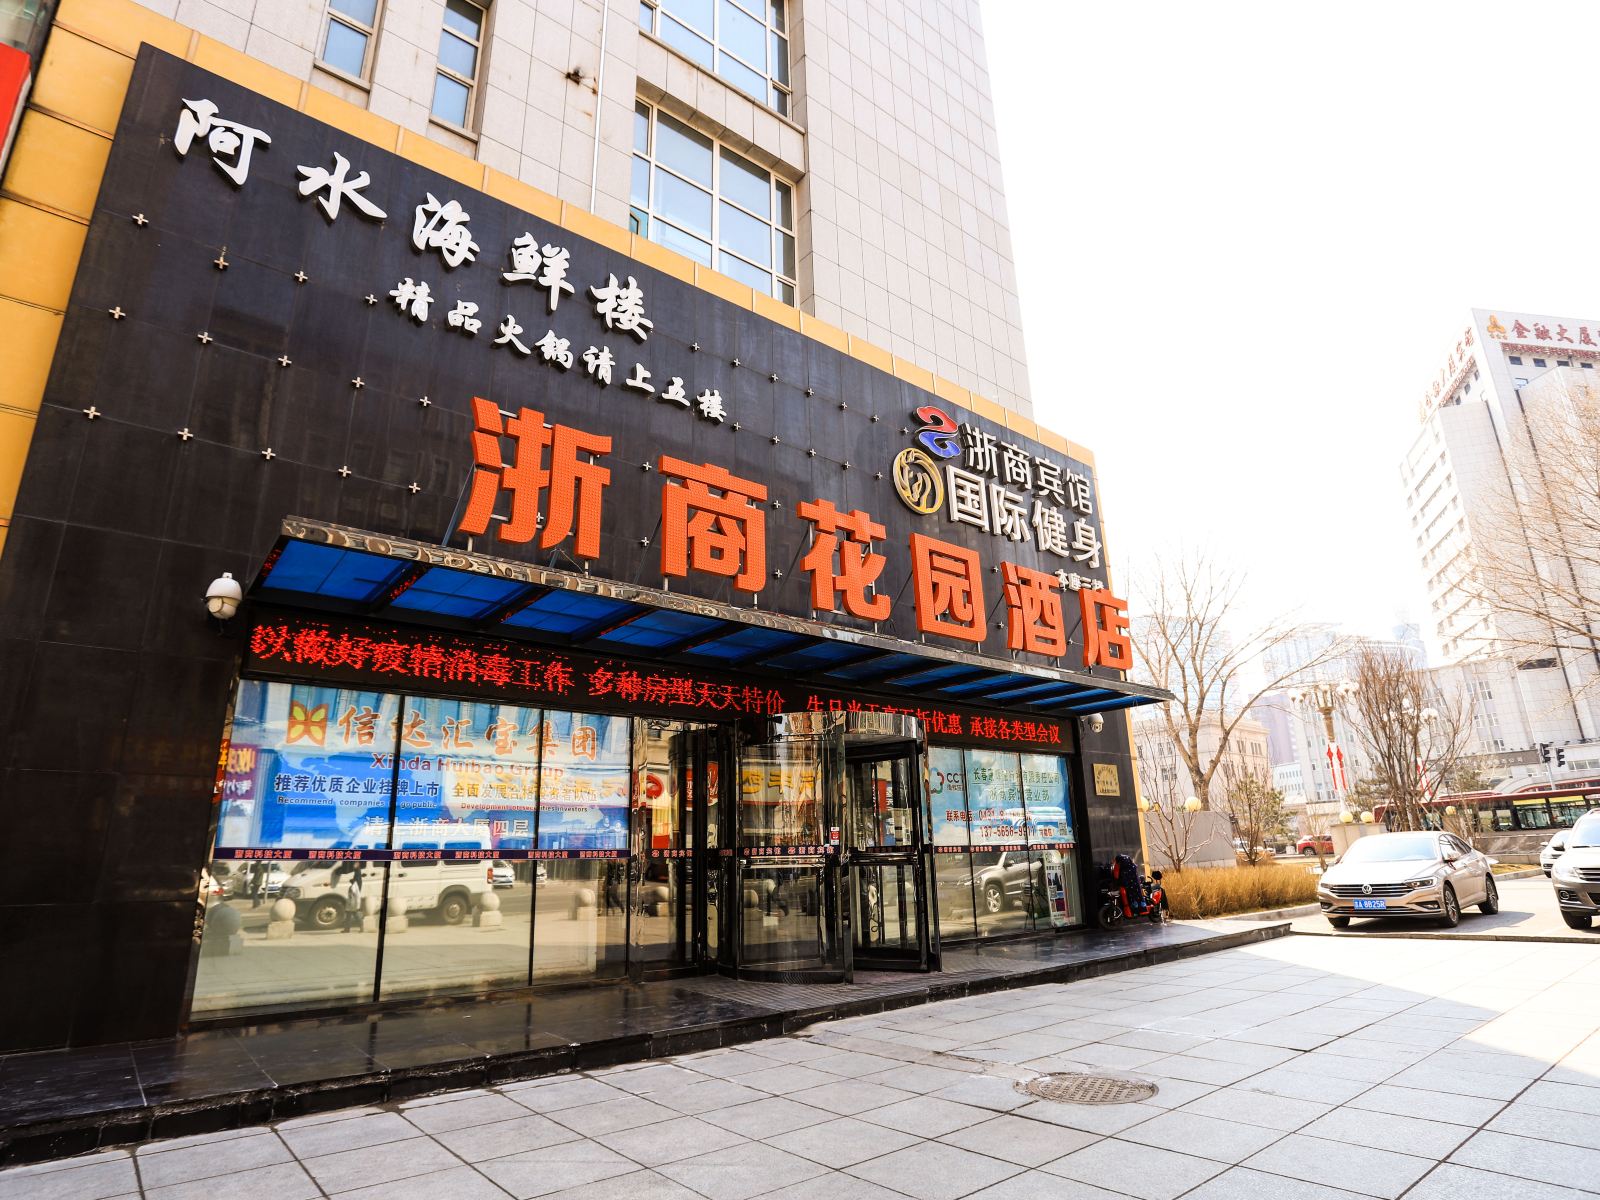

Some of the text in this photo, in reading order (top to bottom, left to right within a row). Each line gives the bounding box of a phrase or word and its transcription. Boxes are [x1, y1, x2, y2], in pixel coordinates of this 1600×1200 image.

[174, 98, 654, 340] 阿水海鲜楼
[389, 277, 727, 423] 精品火锅请上五楼
[1511, 319, 1600, 347] 金融大厦
[958, 422, 1094, 515] 浙商宾馆
[457, 396, 1132, 670] 浙商花园酒店
[946, 464, 1102, 569] 国际健身
[337, 704, 598, 762] 信达汇宝集团
[587, 666, 785, 715] 多种房型天天特价
[969, 715, 1061, 744] 承接各类型会议
[274, 774, 439, 798] 推荐优质企业挂牌上市
[370, 752, 432, 771] Xinda
[437, 758, 505, 776] Huibao
[278, 795, 334, 806] Recommend
[339, 797, 385, 808] companies
[412, 801, 437, 811] public
[460, 802, 509, 811] Development
